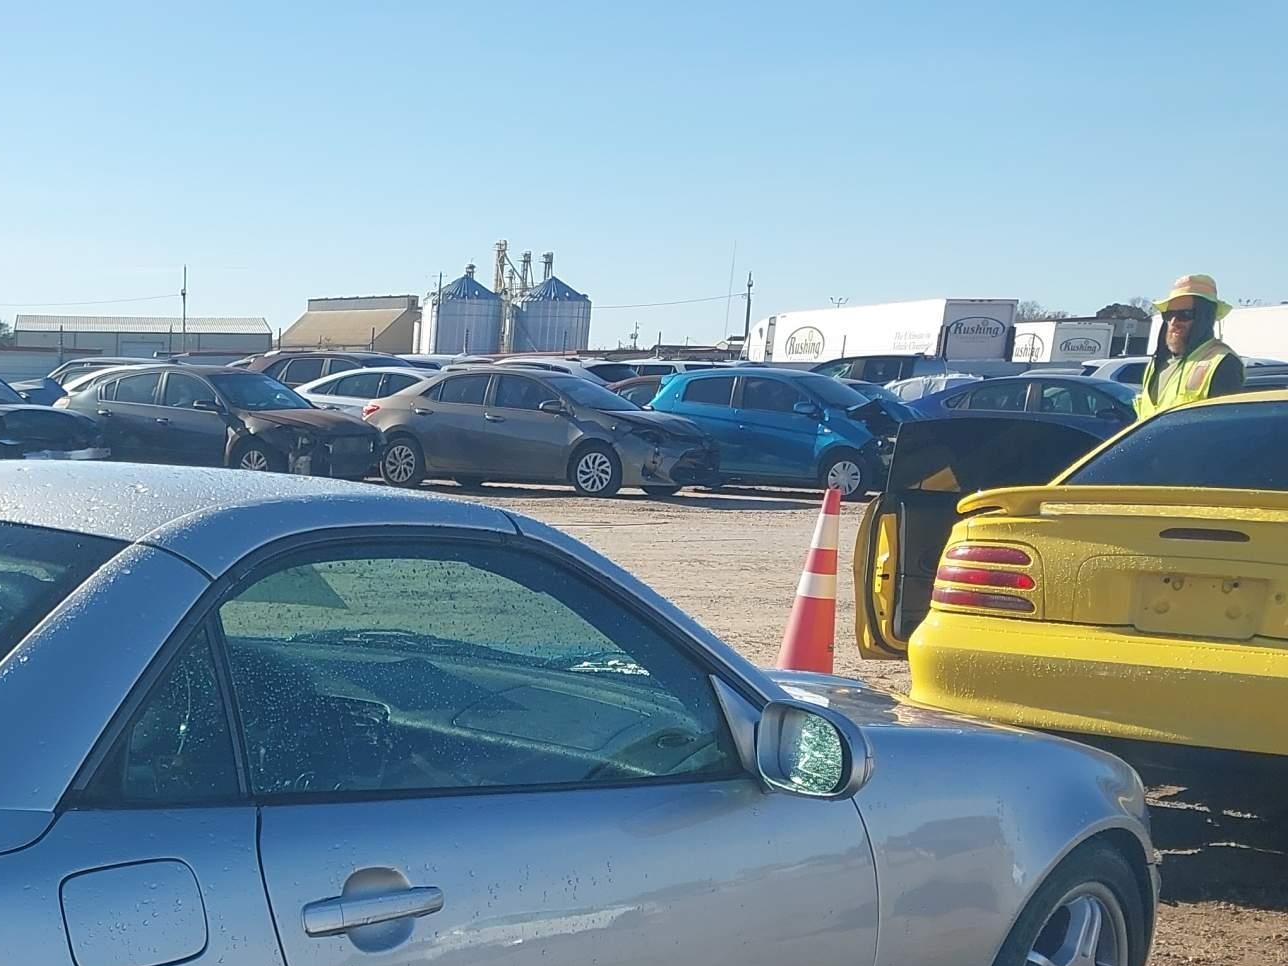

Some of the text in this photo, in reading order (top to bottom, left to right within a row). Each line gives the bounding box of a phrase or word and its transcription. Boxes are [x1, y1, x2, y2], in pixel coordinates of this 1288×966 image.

[953, 321, 1000, 338] Rushing
[788, 336, 821, 359] Rushing
[1014, 344, 1040, 361] ushing
[1064, 341, 1097, 354] Rushing
